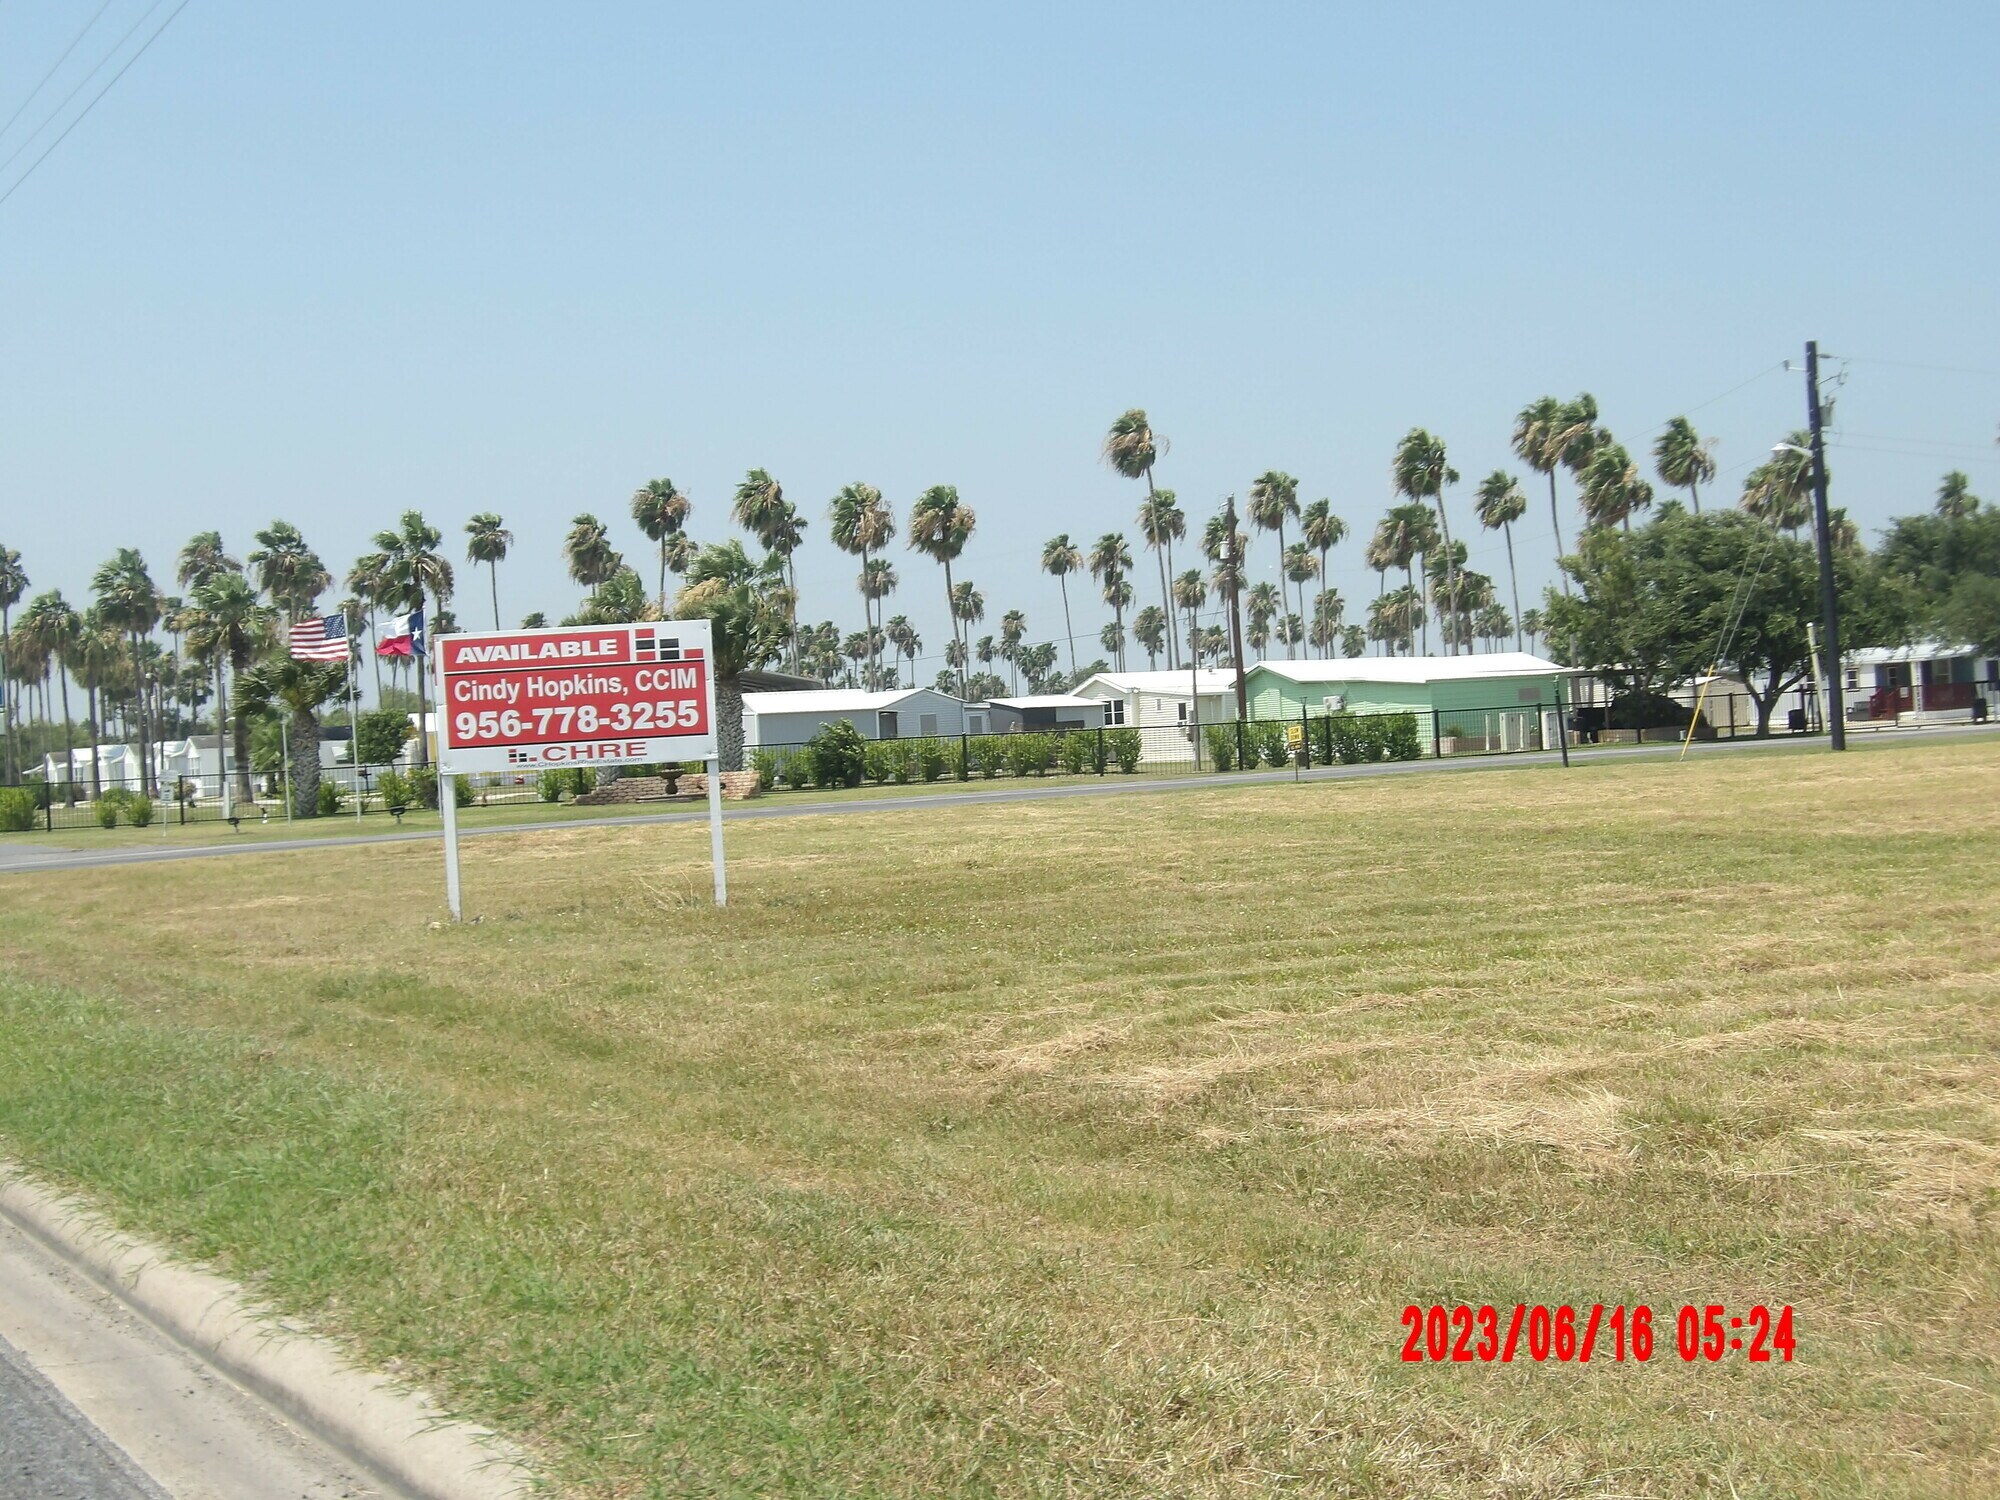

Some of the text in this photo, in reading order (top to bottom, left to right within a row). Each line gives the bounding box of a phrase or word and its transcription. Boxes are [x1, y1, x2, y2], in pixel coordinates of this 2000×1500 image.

[455, 639, 618, 664] AVAILABLE
[454, 667, 697, 705] Cindy Hopkins, CCIM
[456, 699, 699, 740] 956-778-3255
[542, 741, 648, 762] CHRE
